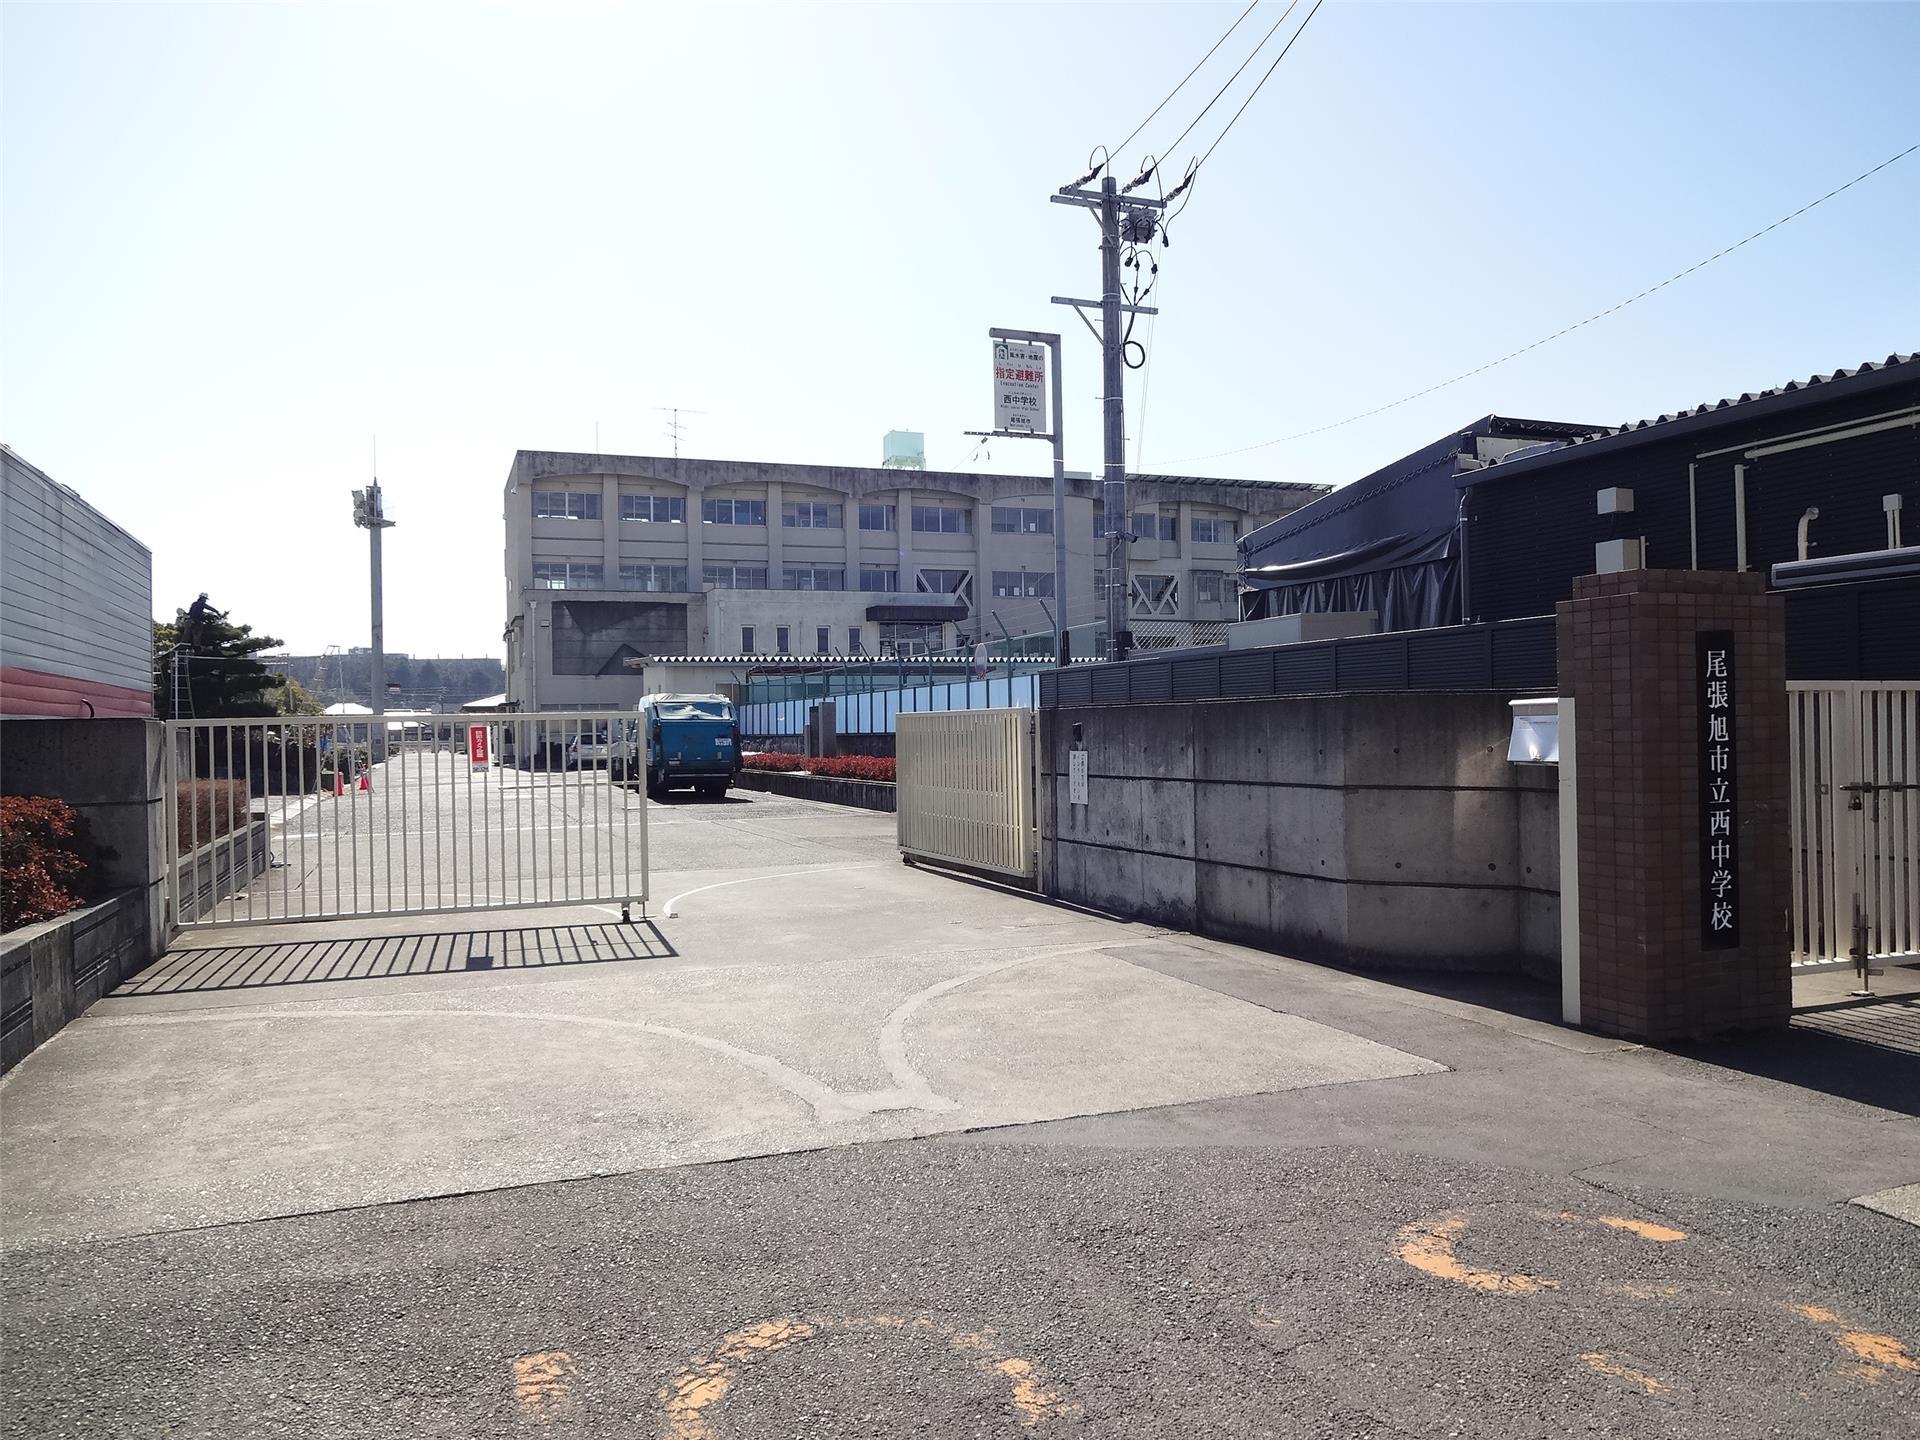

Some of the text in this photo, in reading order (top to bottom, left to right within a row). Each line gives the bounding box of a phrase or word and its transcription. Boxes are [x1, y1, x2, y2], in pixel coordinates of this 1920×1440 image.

[996, 366, 1043, 383] 指定避難所
[1003, 394, 1037, 407] 西中学校
[1706, 649, 1733, 931] 尾張旭市立西中学校
